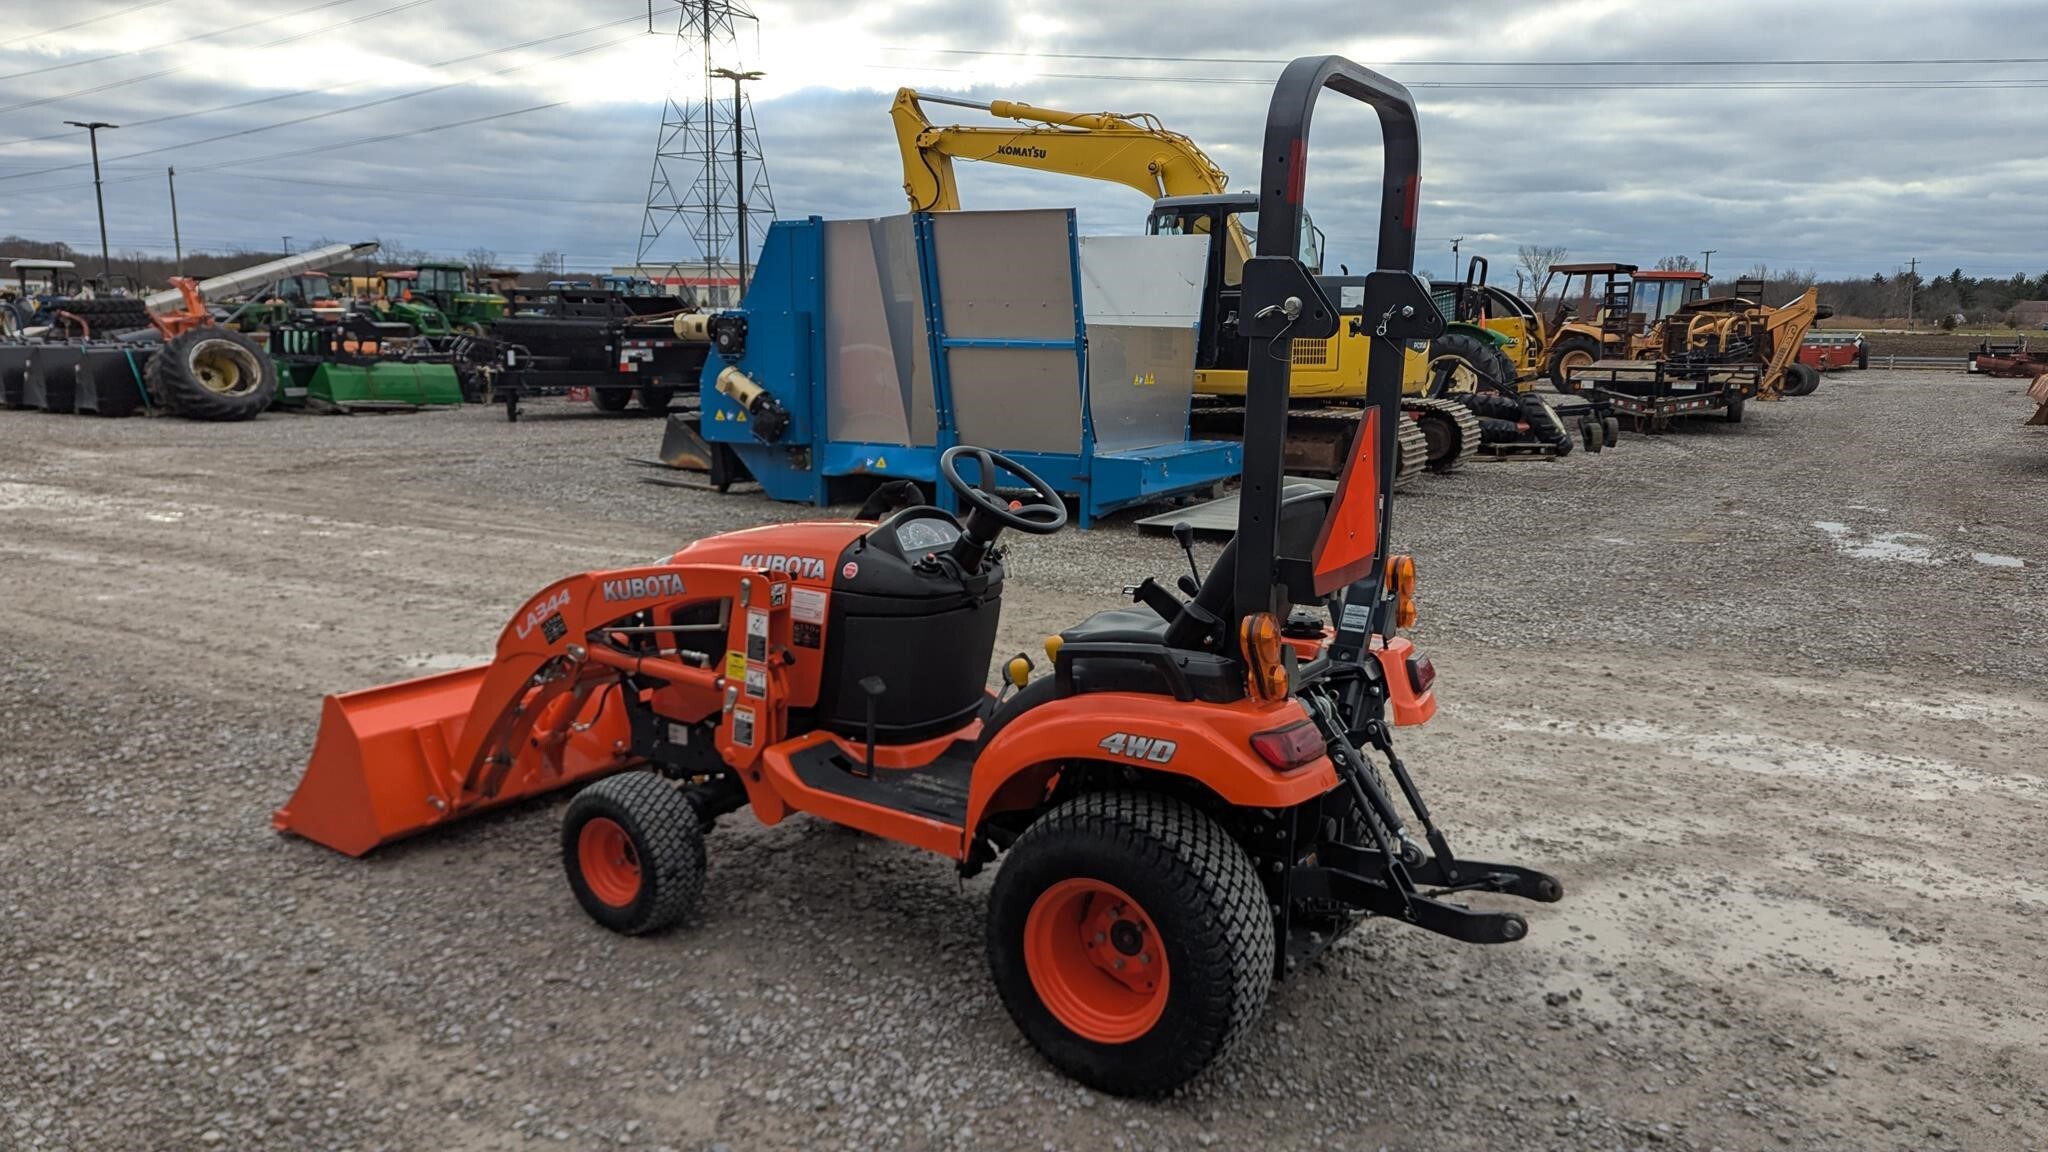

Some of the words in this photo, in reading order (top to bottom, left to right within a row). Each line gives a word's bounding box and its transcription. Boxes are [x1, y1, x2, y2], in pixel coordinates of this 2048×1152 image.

[998, 145, 1046, 158] KOMATSU
[741, 554, 825, 580] KUBOTA
[603, 574, 686, 601] KUBOTA
[516, 588, 571, 640] LA344
[1098, 731, 1177, 764] 4WD
